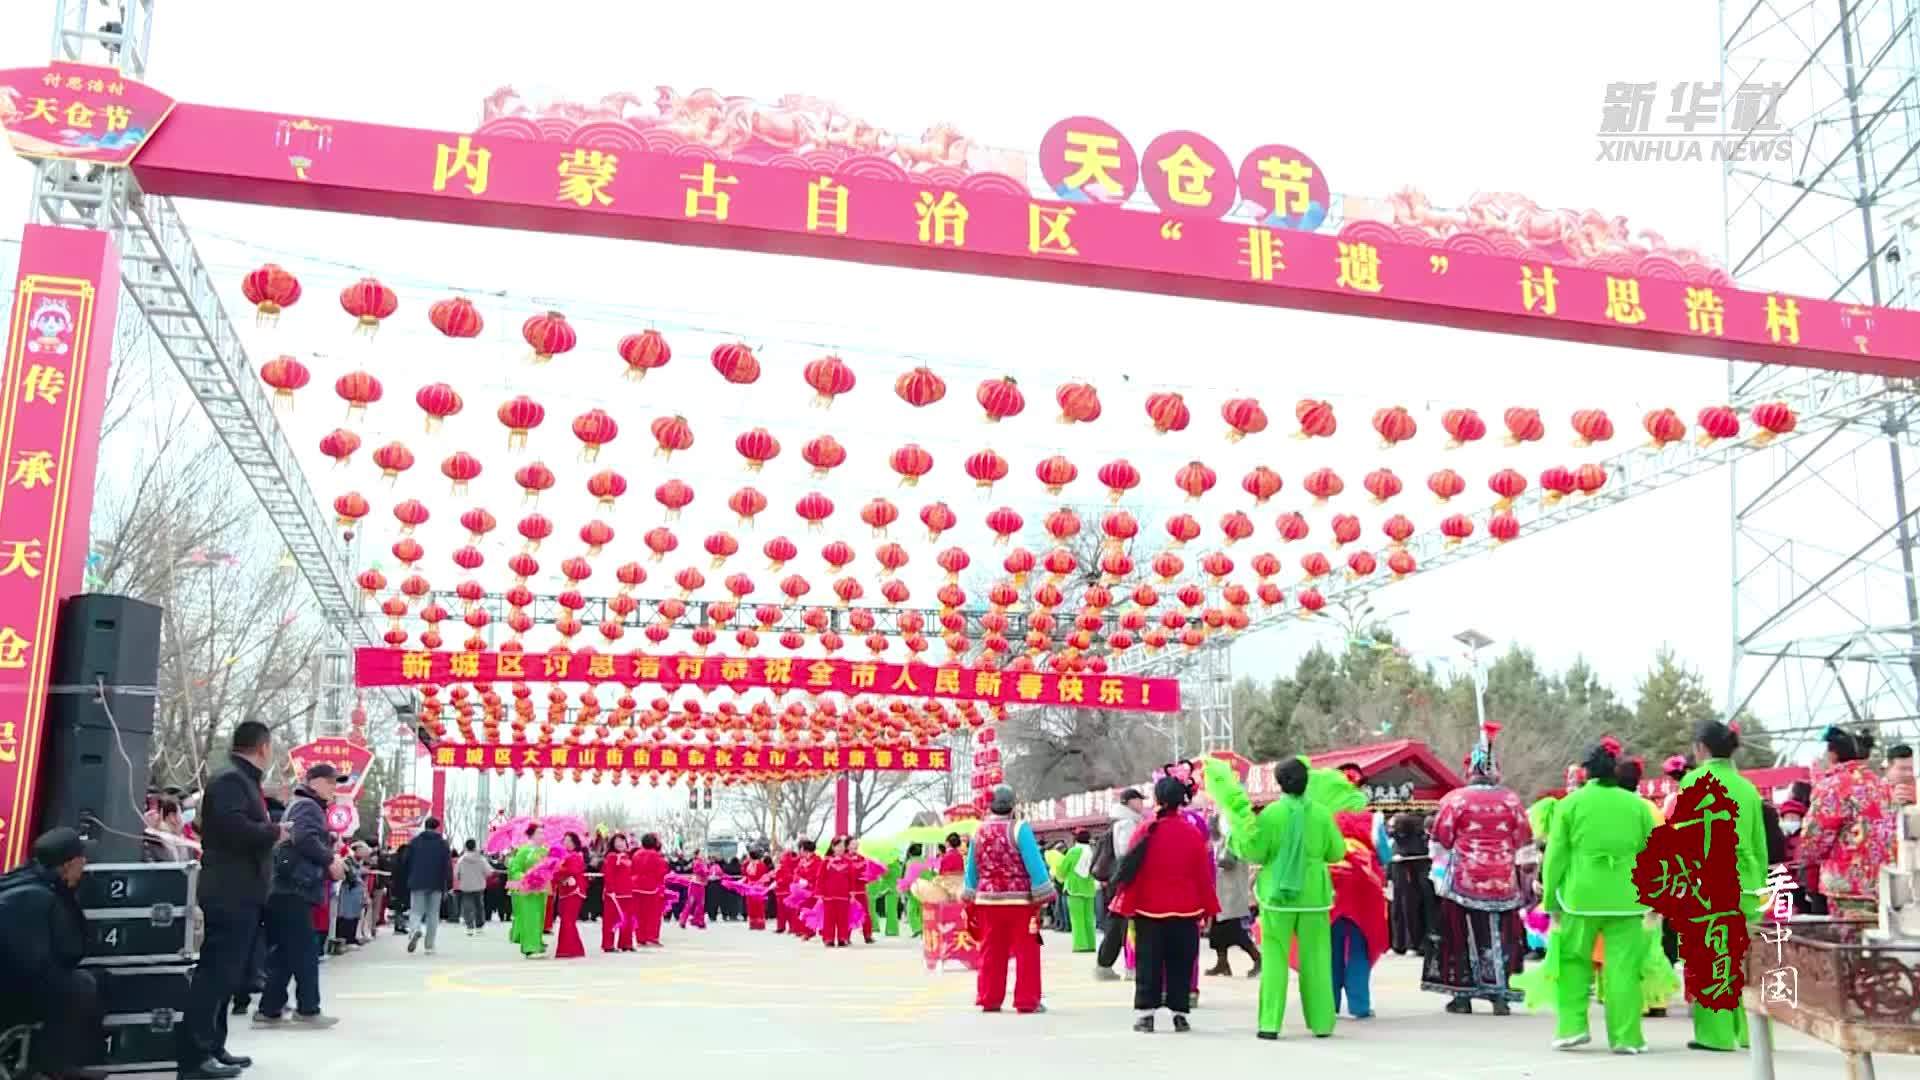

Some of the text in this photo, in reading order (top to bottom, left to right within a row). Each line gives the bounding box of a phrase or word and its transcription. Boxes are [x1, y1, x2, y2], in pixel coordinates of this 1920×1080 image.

[24, 97, 132, 131] 天仓节
[1063, 130, 1313, 217] 天仓节
[110, 879, 125, 898] 2
[104, 927, 118, 947] 4
[104, 1035, 113, 1053] 1
